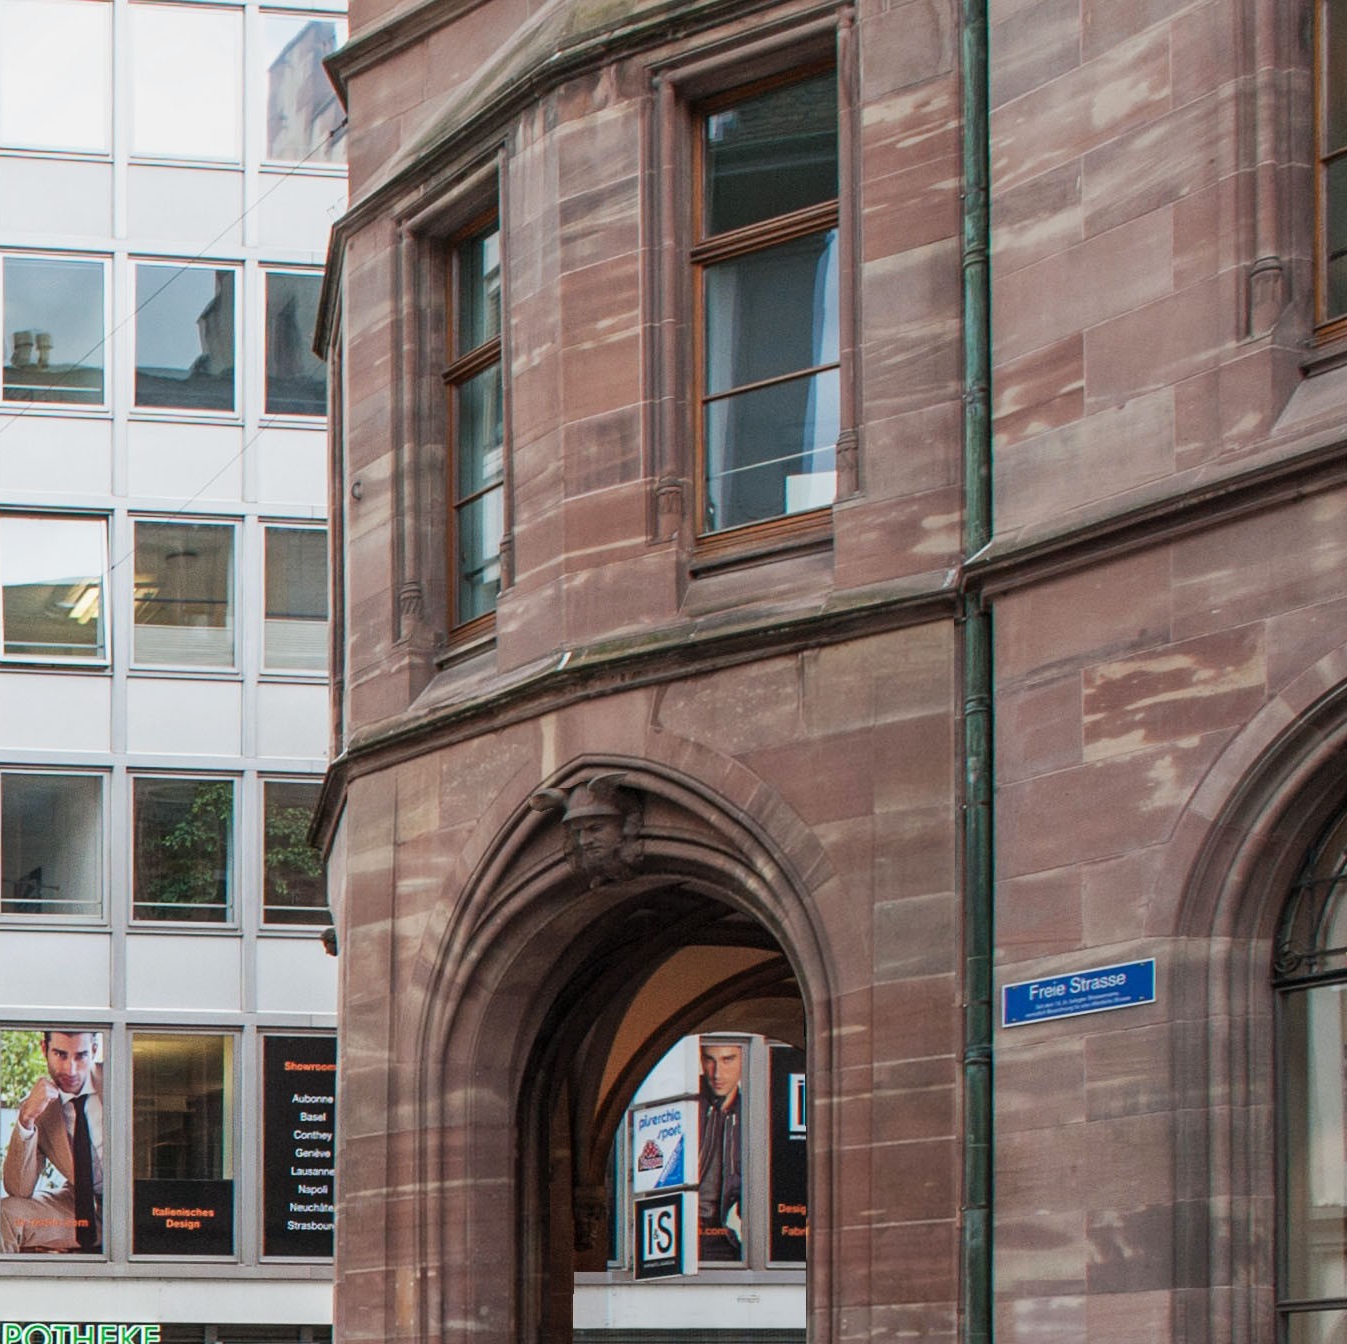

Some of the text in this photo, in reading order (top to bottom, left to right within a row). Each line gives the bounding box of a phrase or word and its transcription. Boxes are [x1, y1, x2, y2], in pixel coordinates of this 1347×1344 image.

[1029, 981, 1066, 1000] Freie
[1069, 973, 1126, 994] Strasse
[292, 1094, 333, 1104] Aubonne
[299, 1112, 327, 1121] Basel
[293, 1130, 332, 1141] Conthey
[298, 1185, 328, 1195] Napoli
[152, 1207, 215, 1217] Italienisches
[289, 1202, 335, 1212] Neuchâte
[165, 1219, 200, 1230] Design
